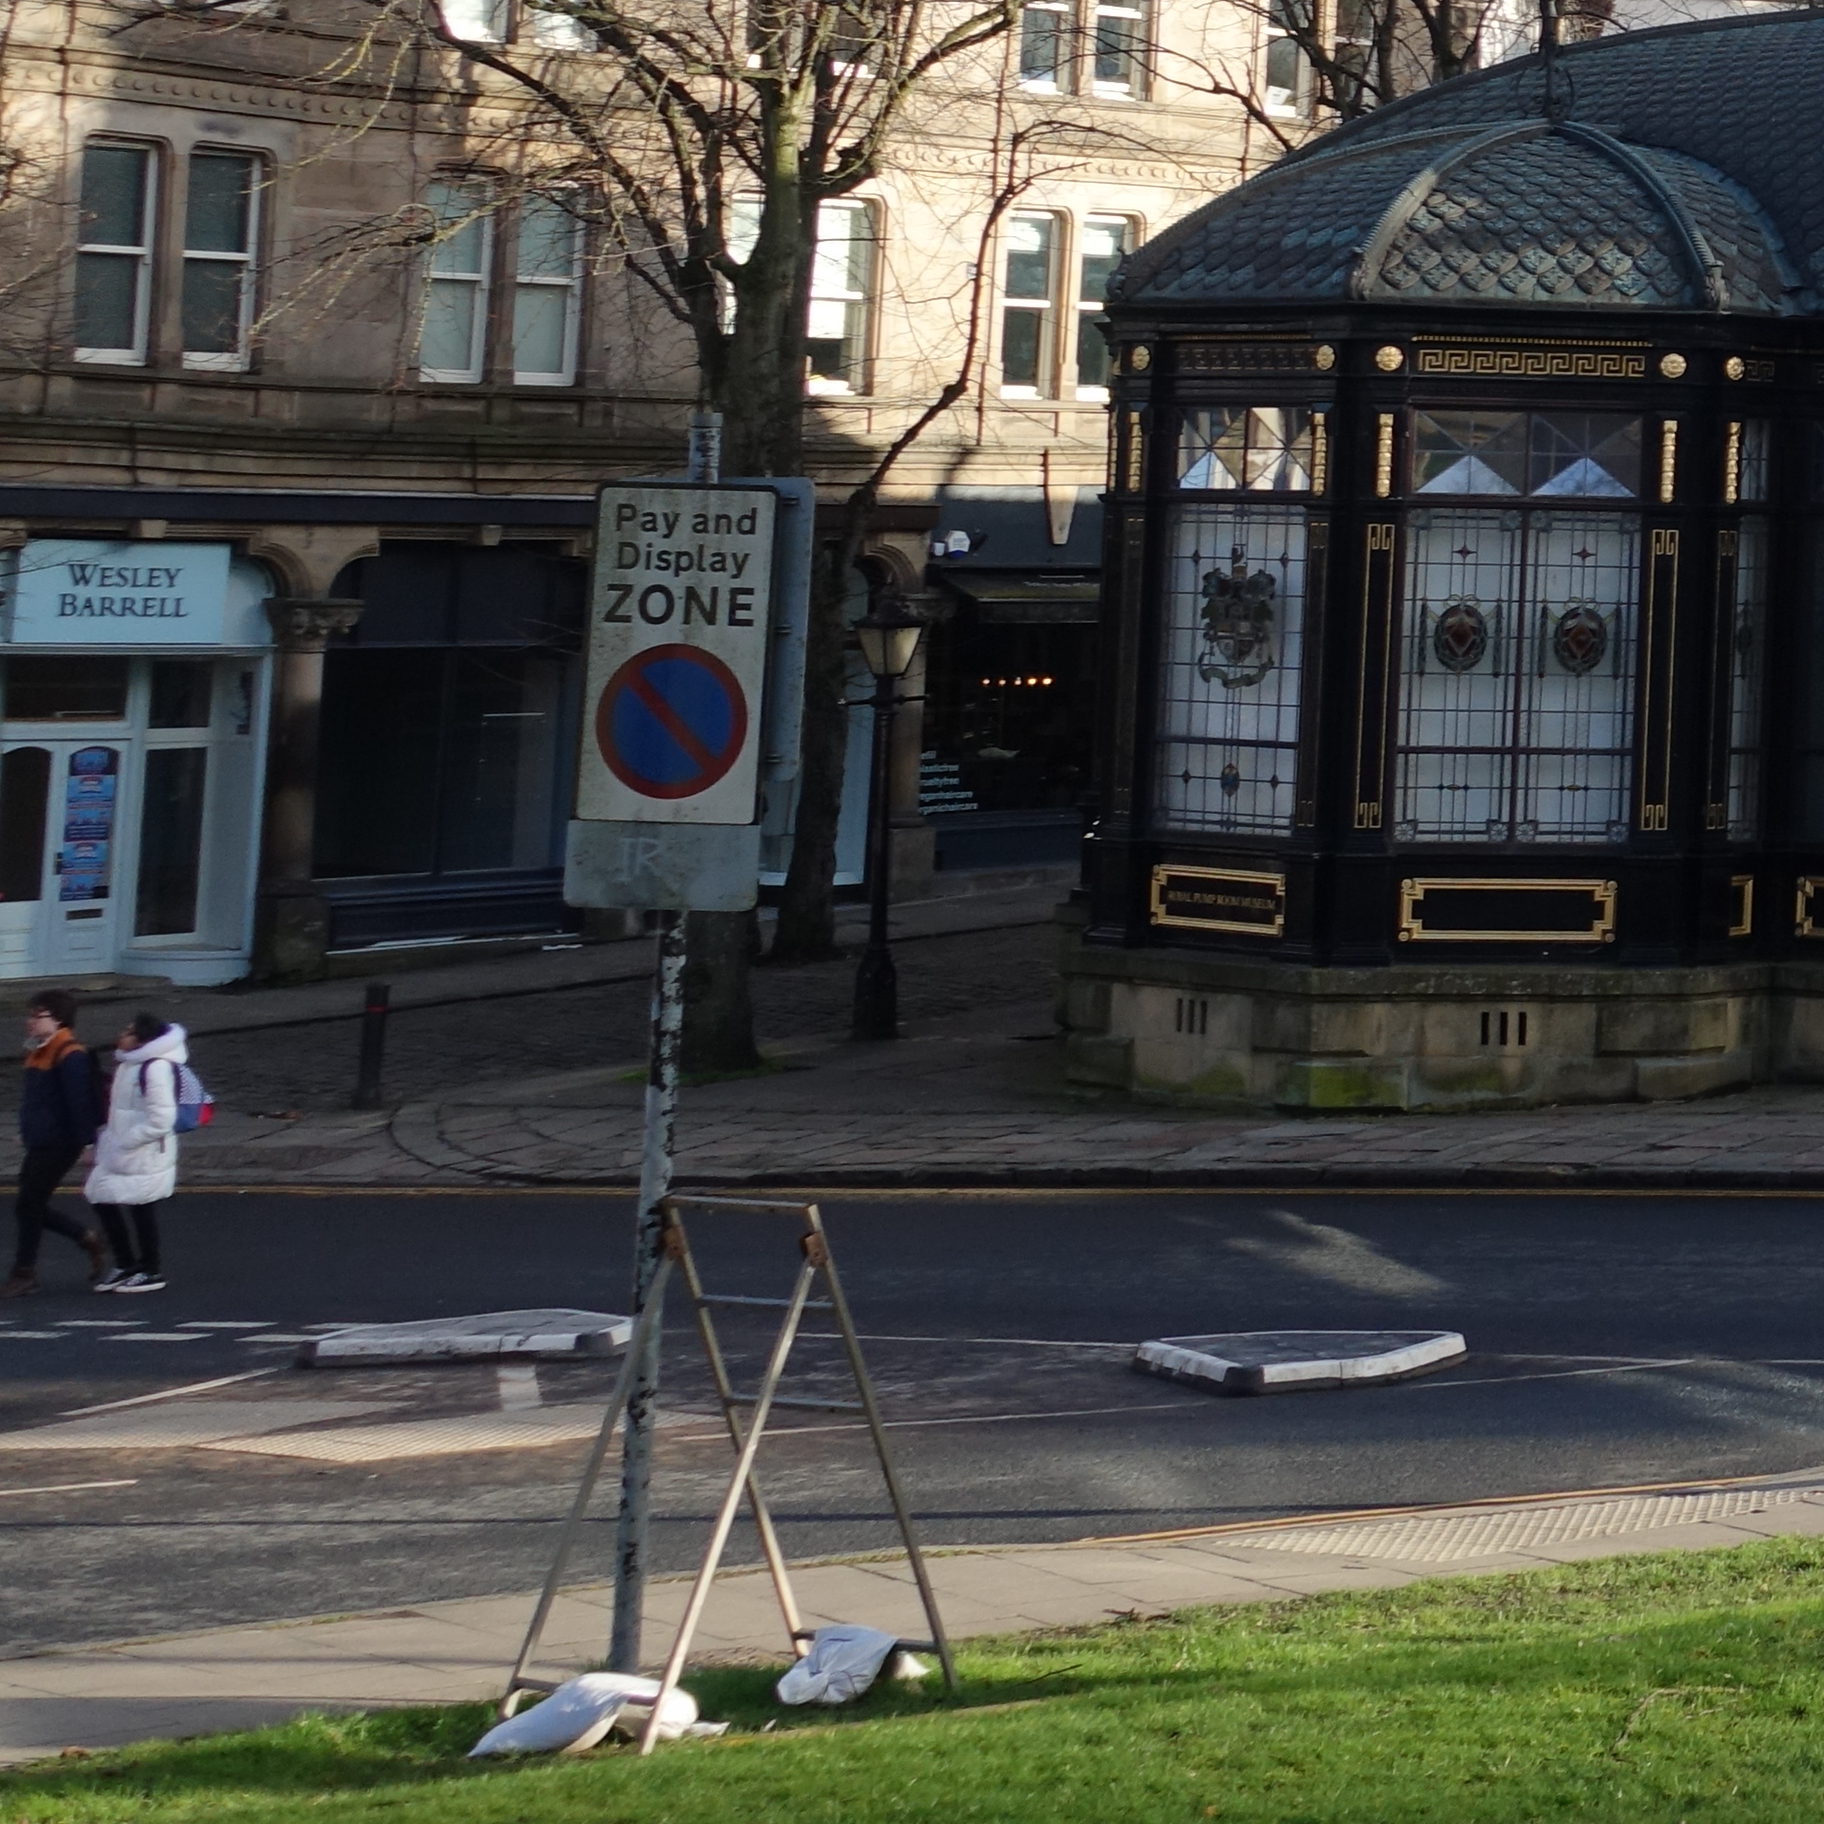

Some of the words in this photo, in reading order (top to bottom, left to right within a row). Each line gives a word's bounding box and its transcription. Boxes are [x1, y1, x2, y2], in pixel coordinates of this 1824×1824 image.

[615, 503, 681, 539] Pay
[692, 507, 758, 535] and
[67, 563, 183, 588] WESLEY
[616, 541, 751, 579] Display
[57, 592, 188, 617] BARRELL
[603, 583, 755, 627] ZONE
